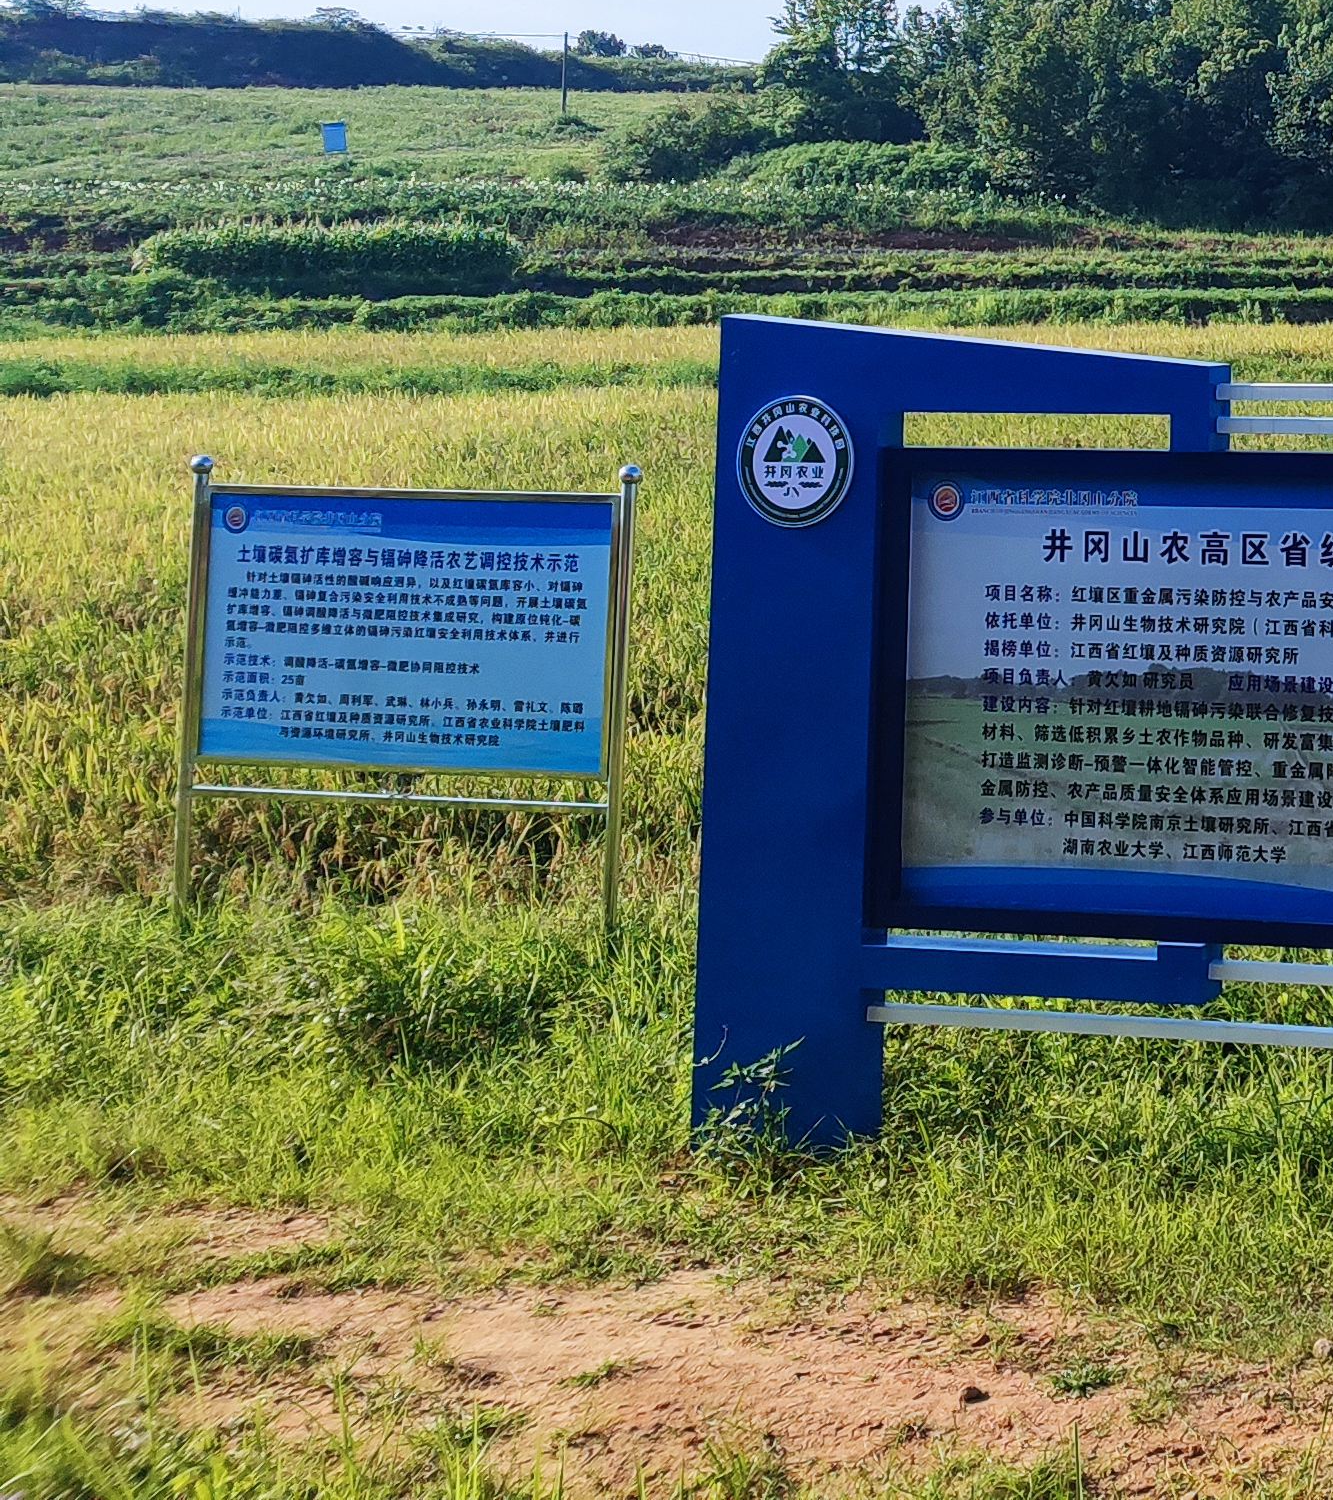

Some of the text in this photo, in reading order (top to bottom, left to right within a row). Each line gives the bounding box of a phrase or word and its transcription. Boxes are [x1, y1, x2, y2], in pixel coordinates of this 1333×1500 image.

[764, 465, 824, 478] 井冈农业
[237, 545, 580, 572] 土壤碳氮扩库增容与镉砷降活农艺调控技术示范
[983, 639, 1300, 666] 揭榜单位：江西省红壤及种质资源研究所
[982, 667, 1137, 688] 项目负责人：黄欠如
[1142, 673, 1194, 691] 研究员
[1062, 837, 1287, 864] 湖南农业大学、江西师范大学
